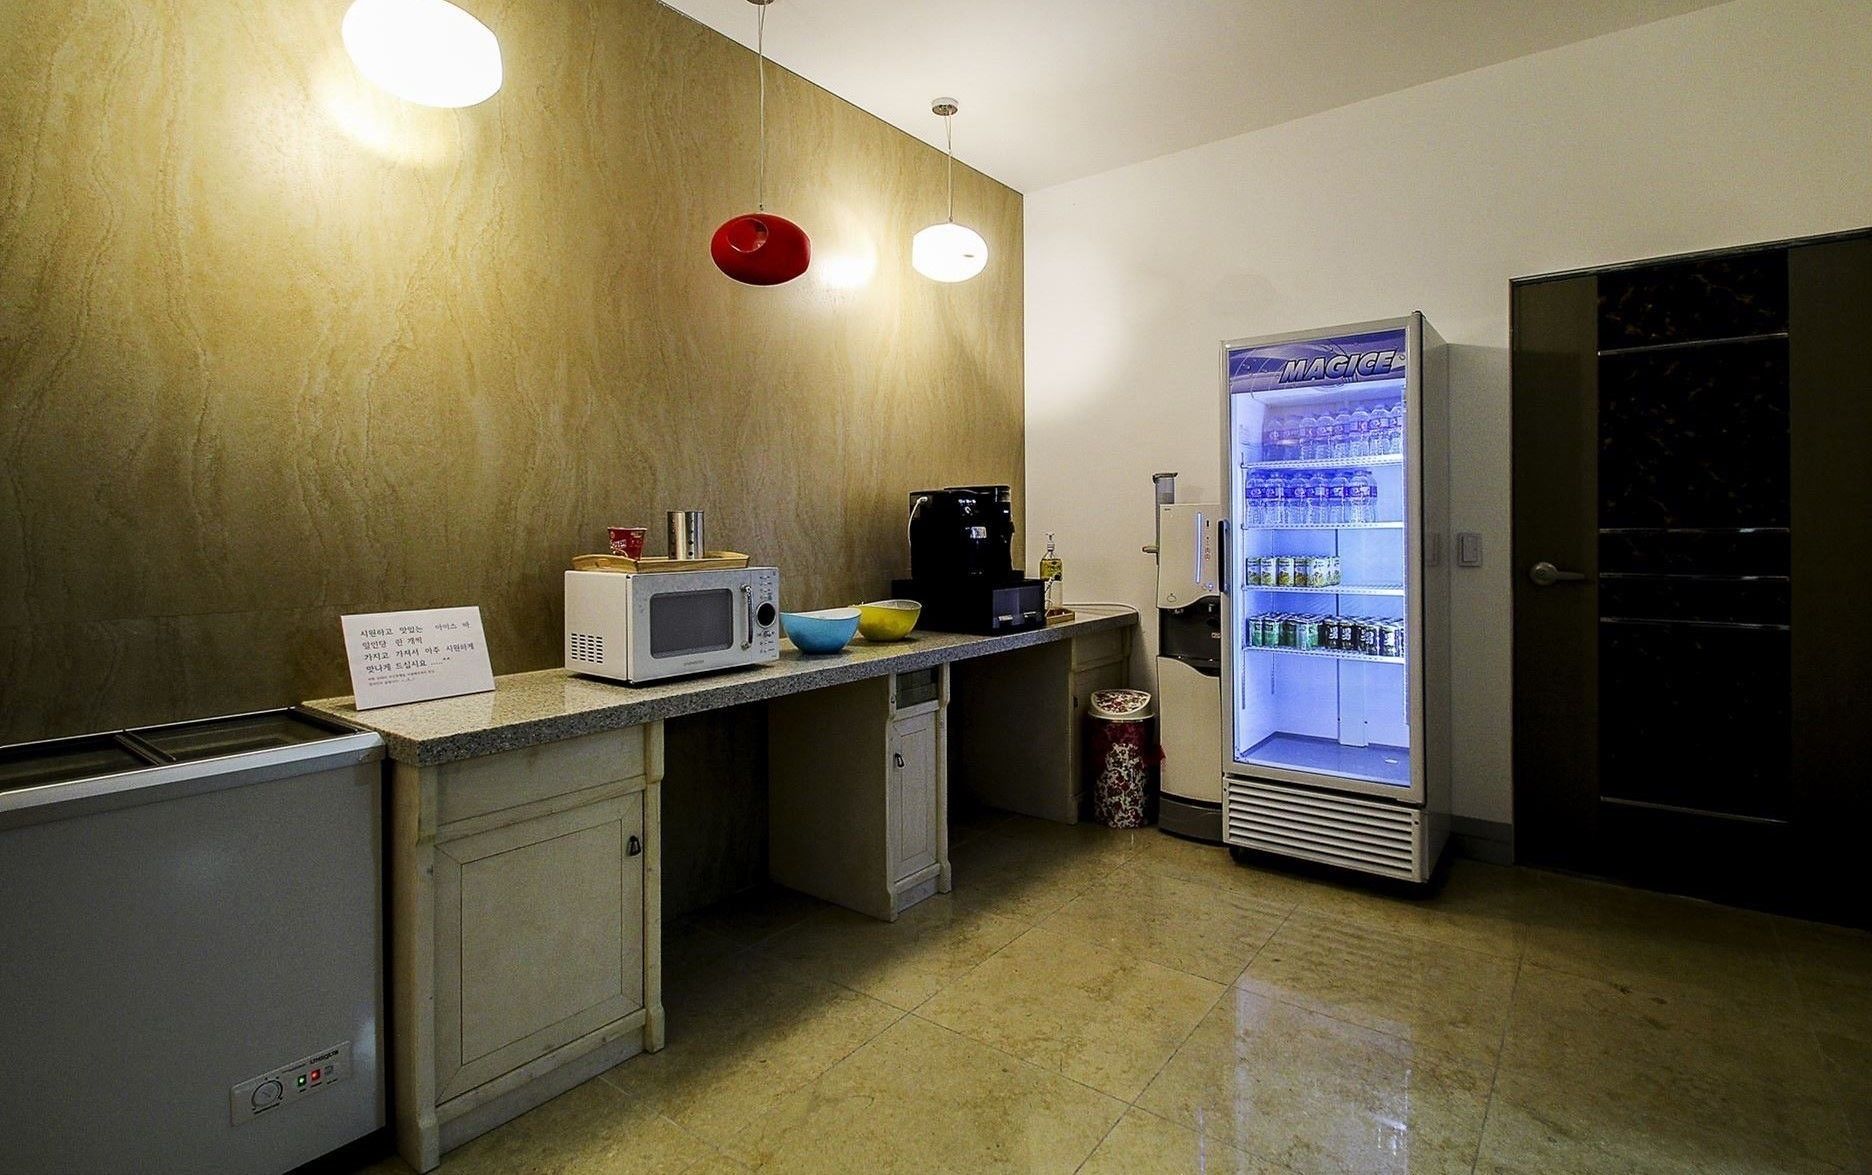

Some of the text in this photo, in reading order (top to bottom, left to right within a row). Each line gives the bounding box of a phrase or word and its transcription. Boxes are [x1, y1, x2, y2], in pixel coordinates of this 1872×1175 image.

[1279, 349, 1397, 383] MAGICE
[360, 628, 394, 638] 시원하고
[399, 626, 423, 635] 맛있는
[364, 652, 389, 661] 가지고
[425, 646, 440, 654] 아주
[446, 642, 474, 652] 시원하게
